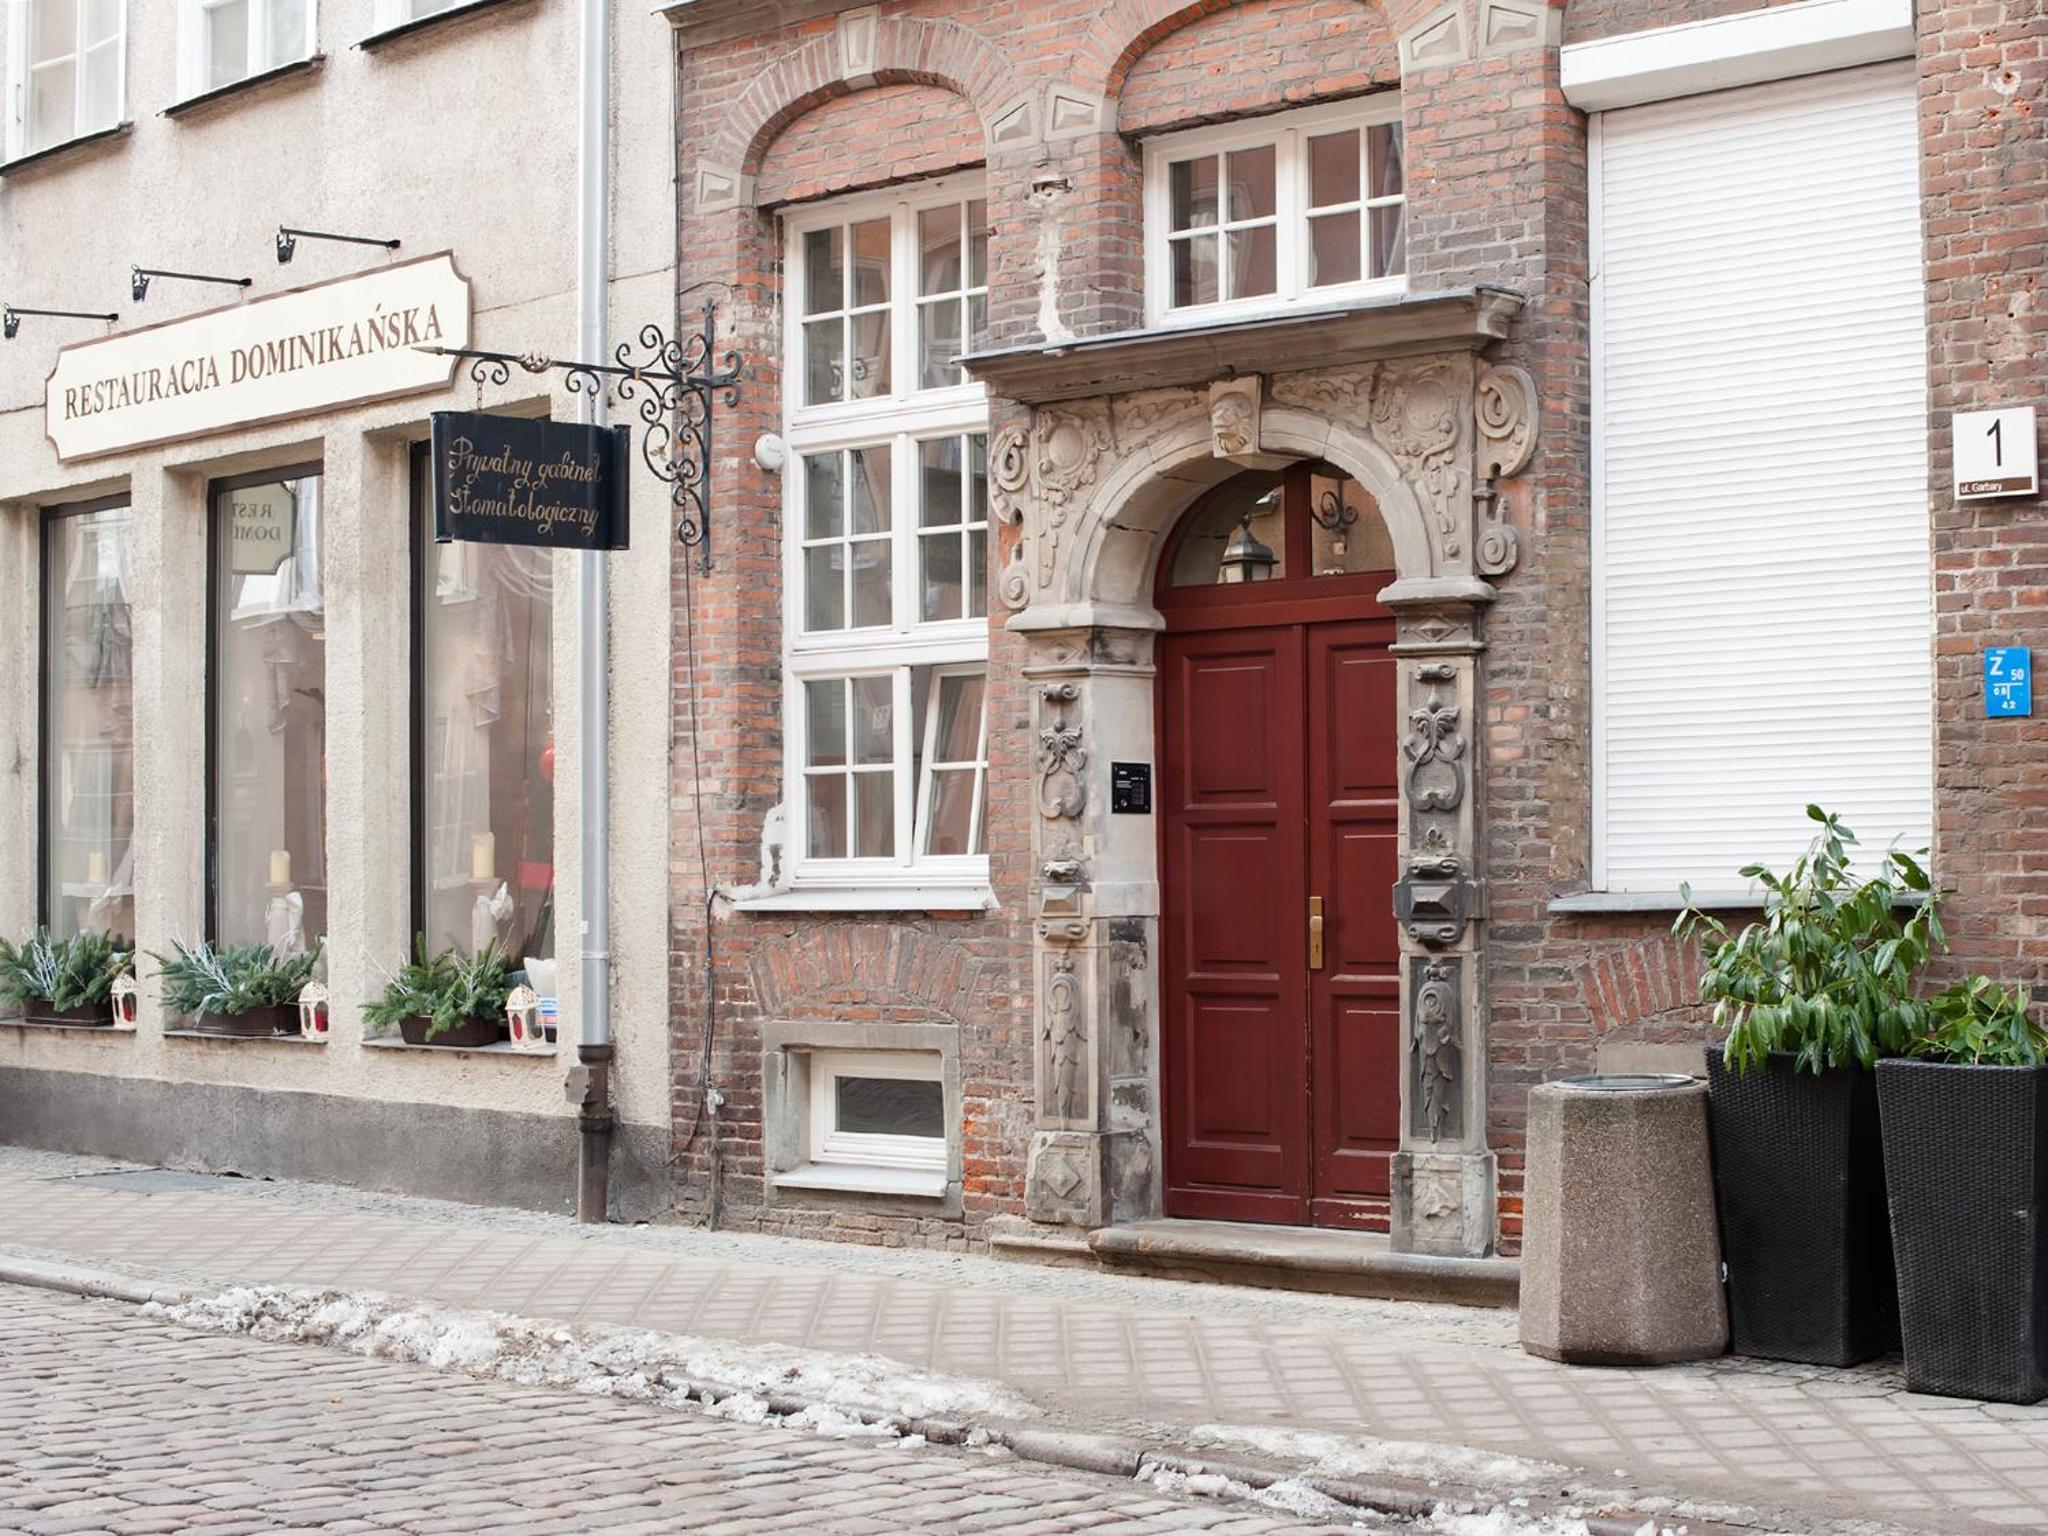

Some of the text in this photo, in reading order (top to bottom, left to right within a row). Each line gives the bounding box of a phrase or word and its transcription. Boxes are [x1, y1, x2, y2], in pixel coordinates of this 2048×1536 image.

[65, 303, 443, 420] RESTAURACJA DOMINIKAŃSKA
[449, 436, 602, 490] Prywatny gabinet
[1987, 418, 2002, 467] 1
[1989, 656, 2004, 676] Z
[2010, 668, 2025, 681] 50
